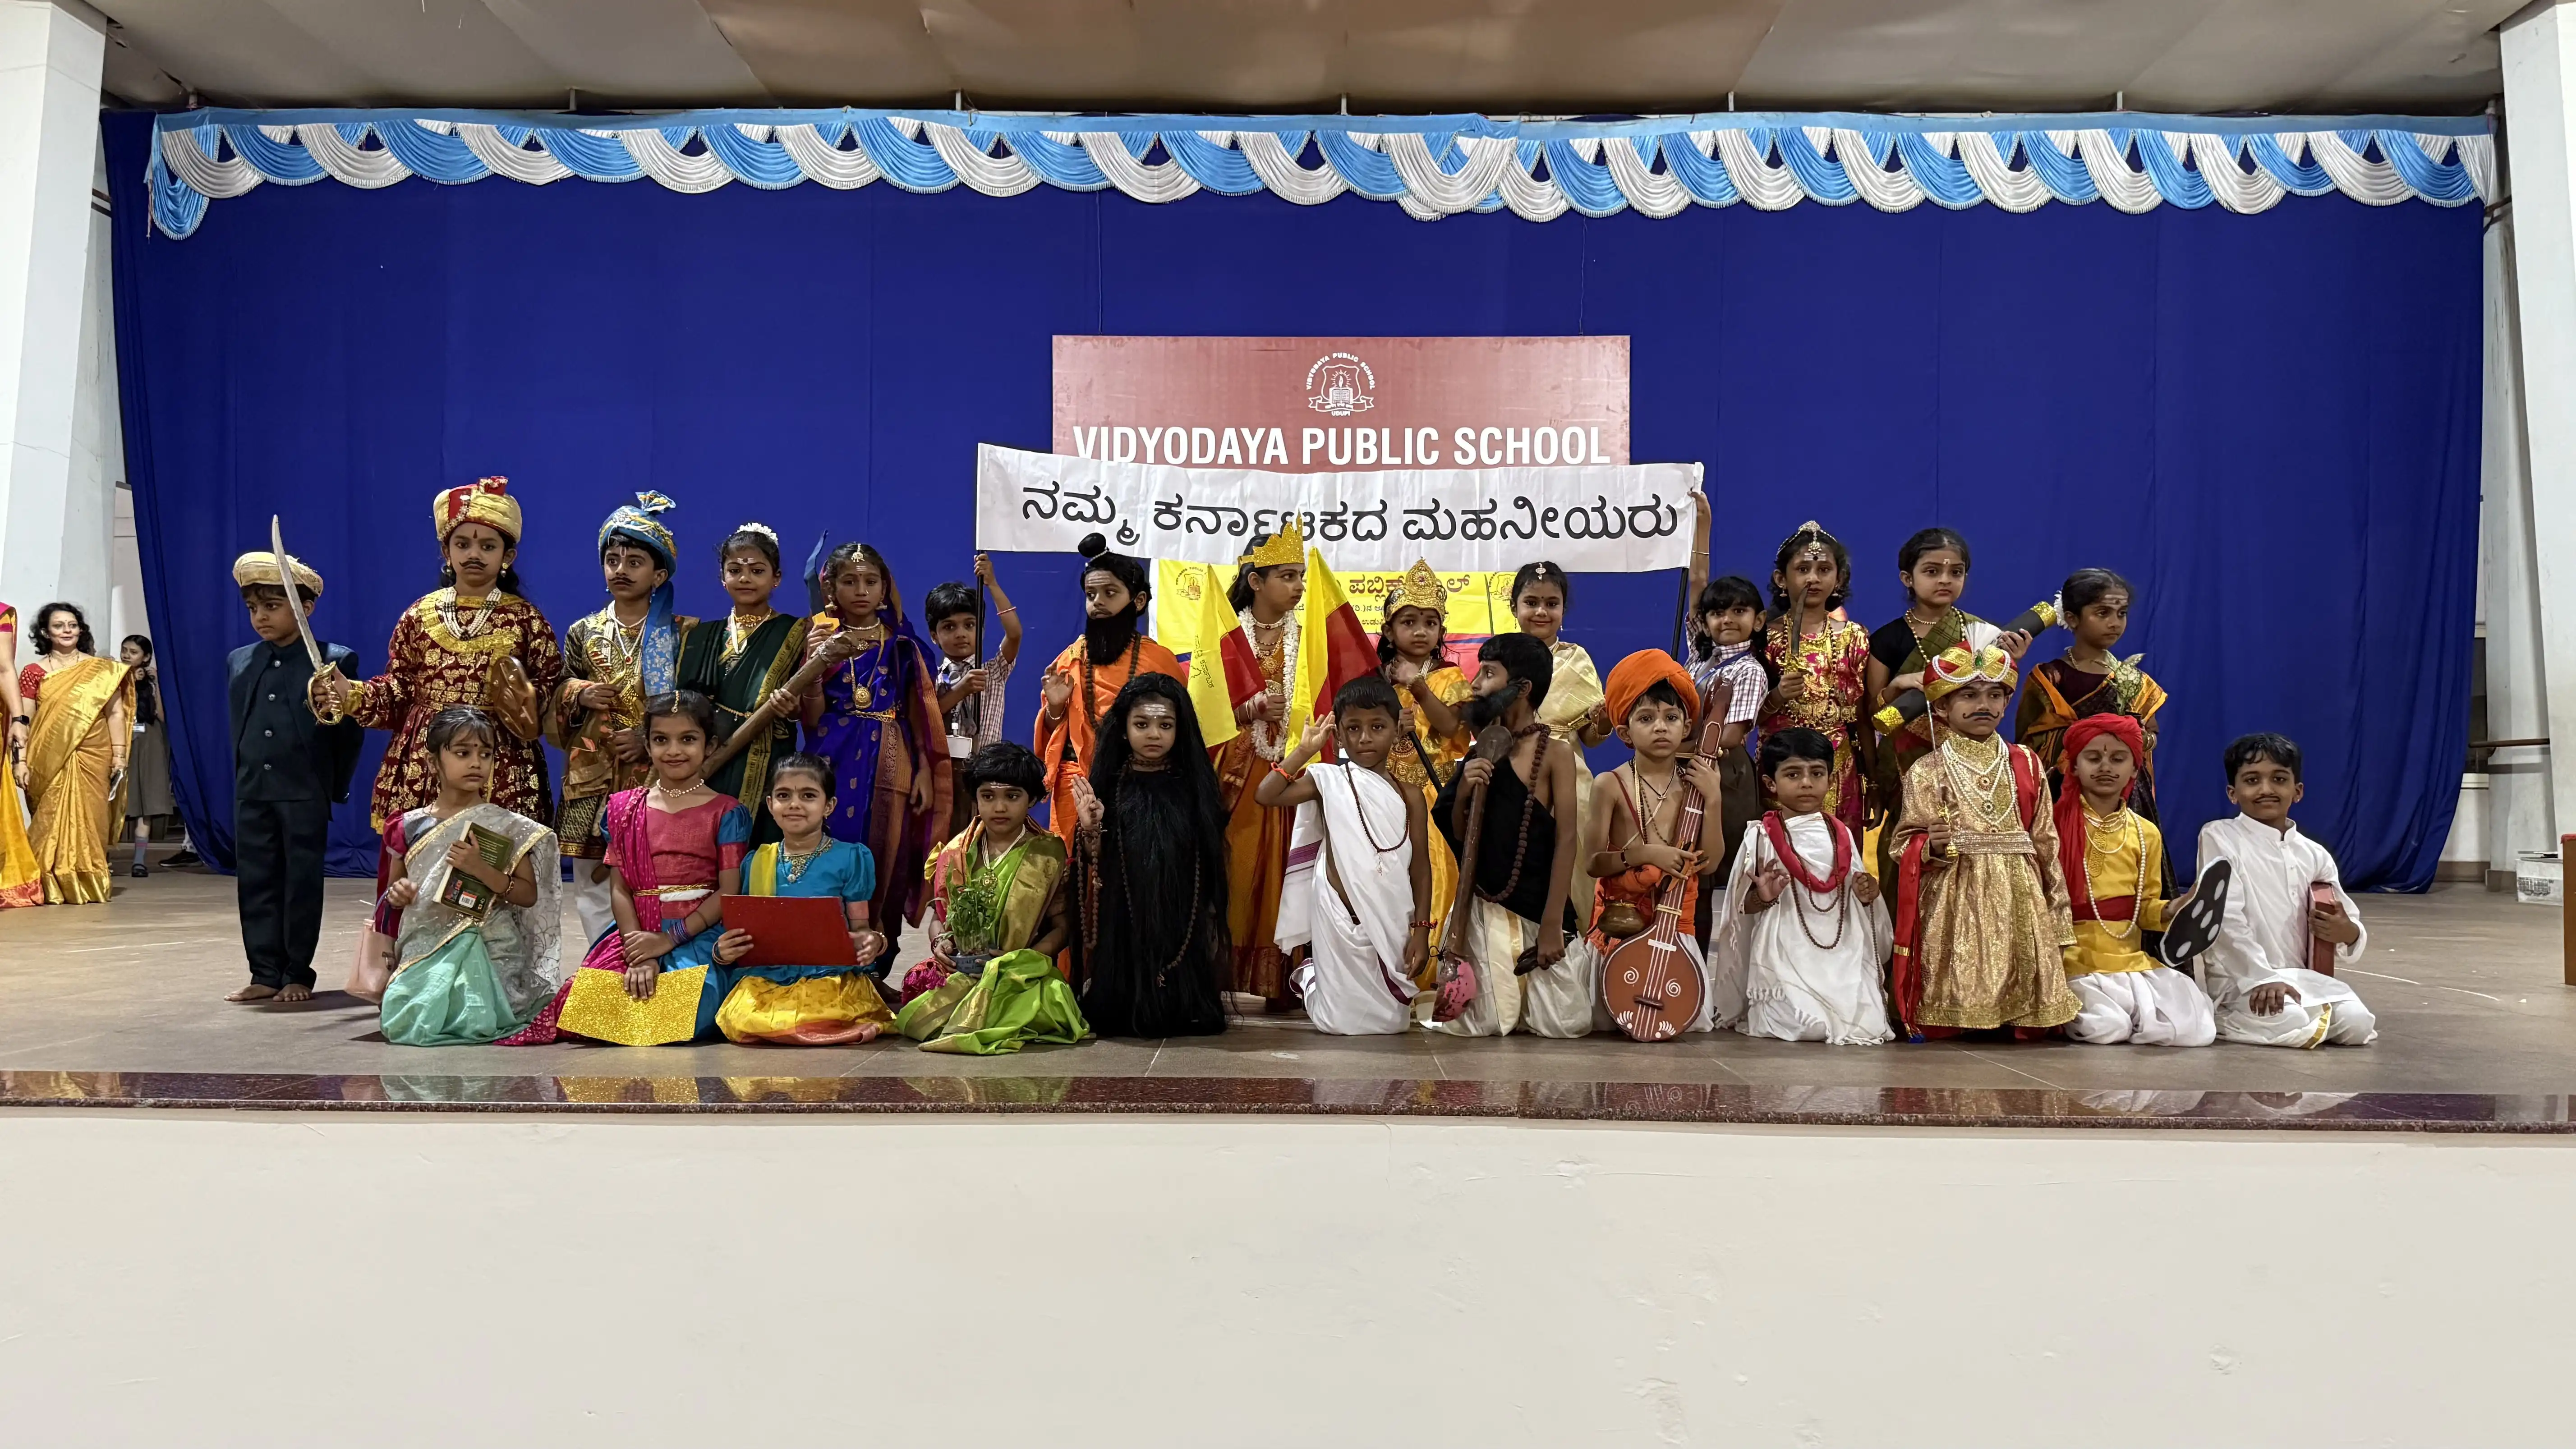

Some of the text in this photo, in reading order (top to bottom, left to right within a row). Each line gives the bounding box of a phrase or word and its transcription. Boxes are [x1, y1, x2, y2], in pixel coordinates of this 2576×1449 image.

[1306, 352, 1375, 390] VIDYODAYA PUBLIC SCHOOL
[1073, 426, 1611, 465] VIDYODAYA PUBLIC SCHOOL
[1022, 480, 1678, 546] ನಮ್ಮ ಕರ್ನಾಟಕದ ಮಹನೀಯರು
